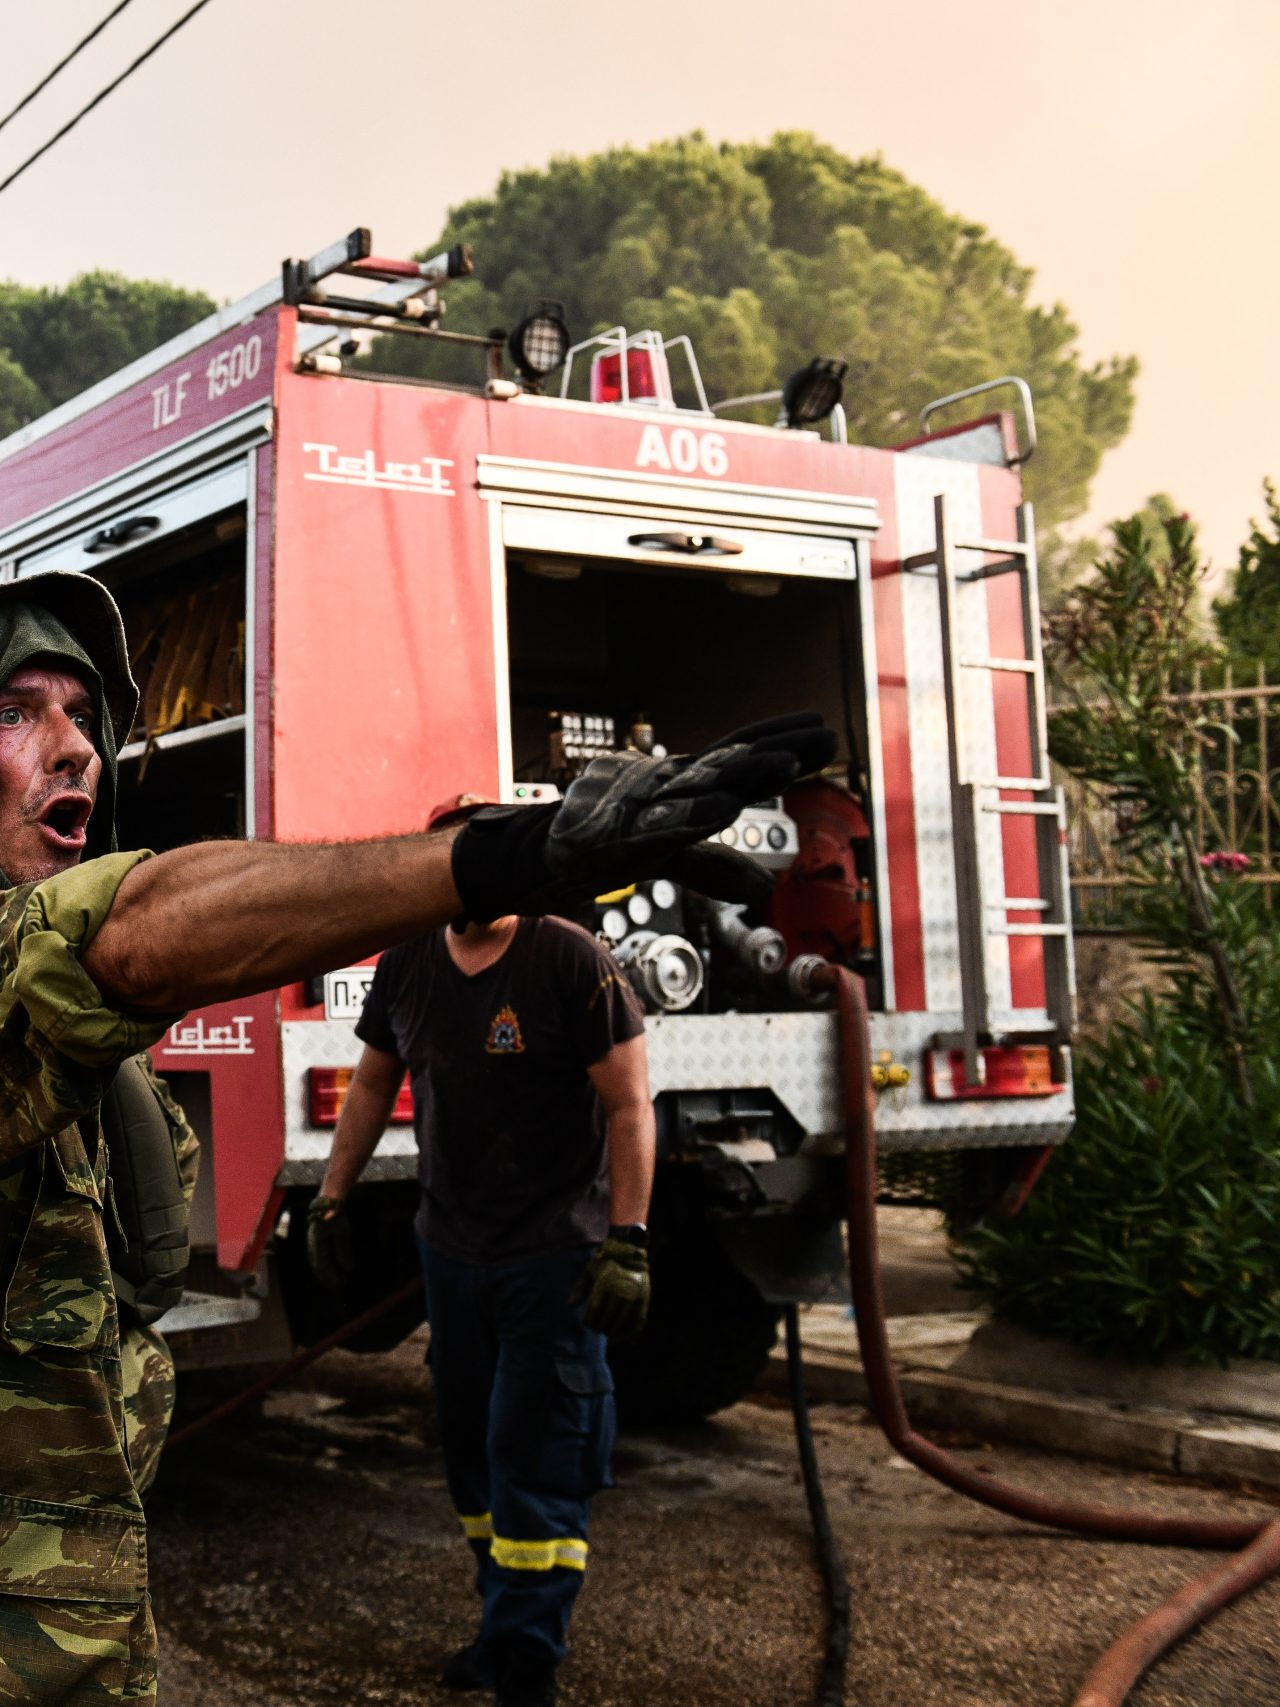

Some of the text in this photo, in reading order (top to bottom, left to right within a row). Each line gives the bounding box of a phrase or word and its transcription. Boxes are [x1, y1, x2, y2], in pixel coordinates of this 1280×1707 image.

[151, 334, 262, 430] TLF 1500
[635, 424, 729, 477] A06
